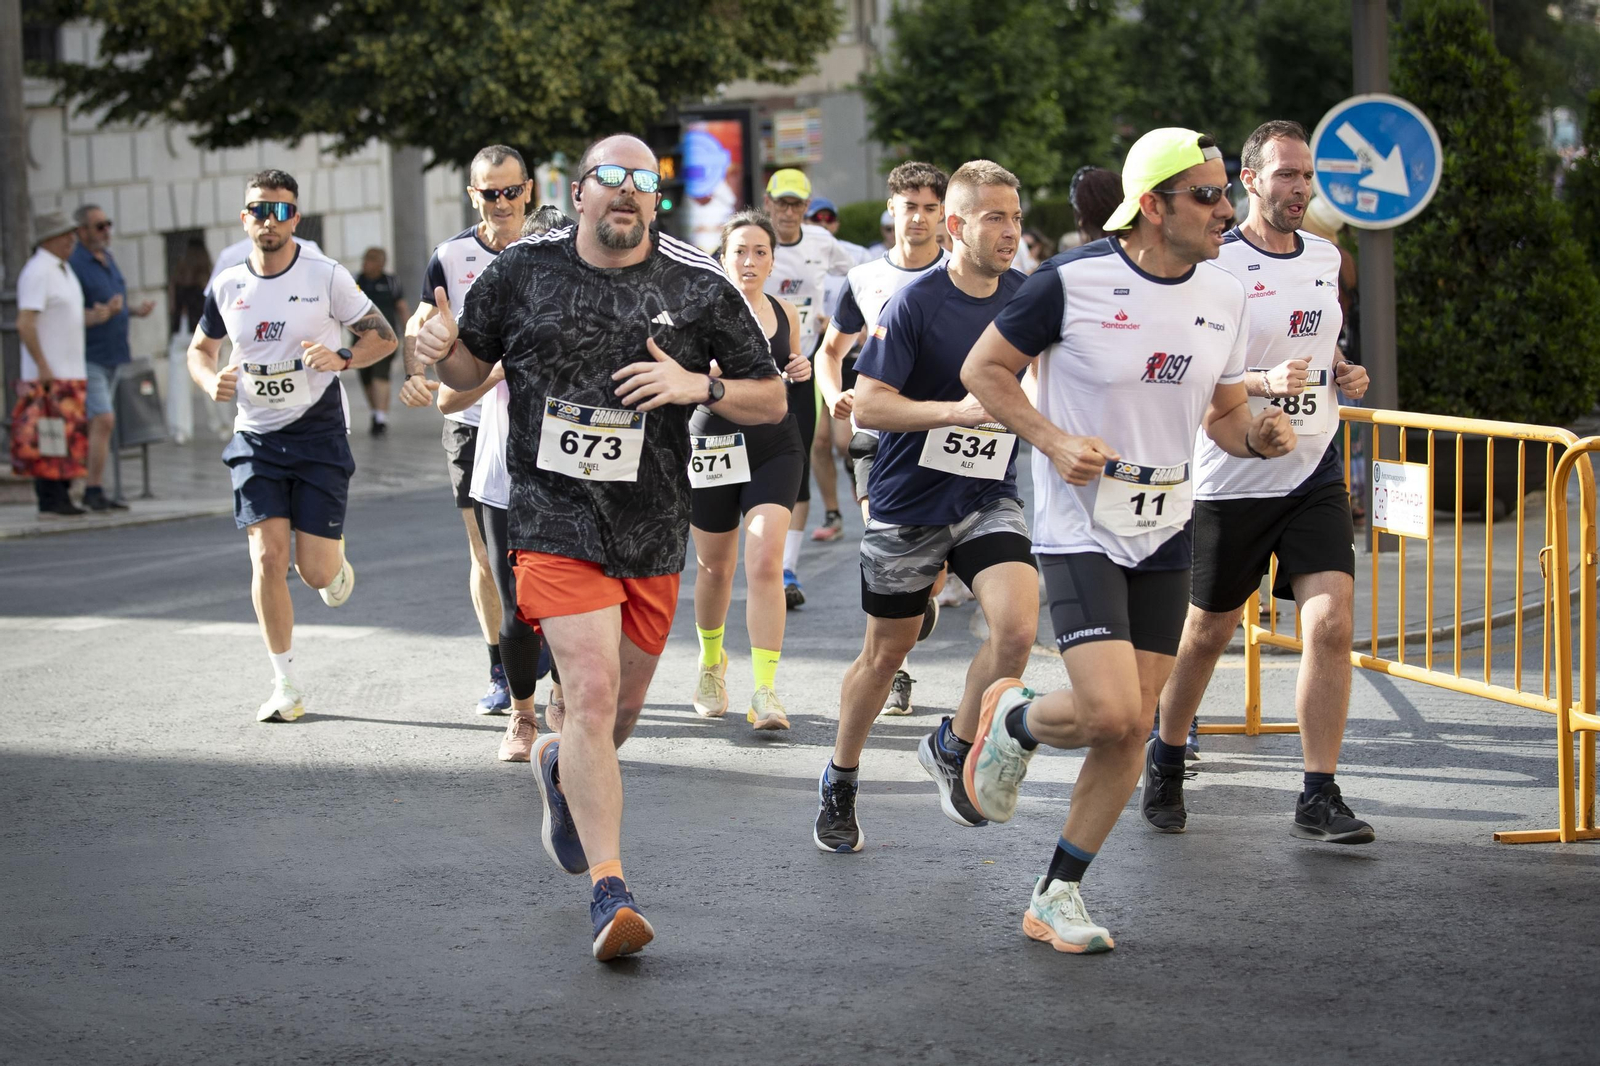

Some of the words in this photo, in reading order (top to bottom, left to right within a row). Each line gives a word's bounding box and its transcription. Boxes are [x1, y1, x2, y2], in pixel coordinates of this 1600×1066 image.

[301, 295, 320, 303] mupol
[1101, 321, 1141, 330] Santander
[1208, 322, 1225, 332] mupol
[254, 378, 295, 396] 266
[590, 409, 634, 425] GRANADA
[560, 430, 622, 461] 673
[705, 435, 735, 448] GRANADA
[943, 432, 998, 460] 534
[578, 461, 600, 471] DANIEL
[692, 453, 732, 473] 671
[960, 461, 975, 469] ALEX
[1130, 492, 1167, 516] 11
[1063, 627, 1111, 643] LURBEL
